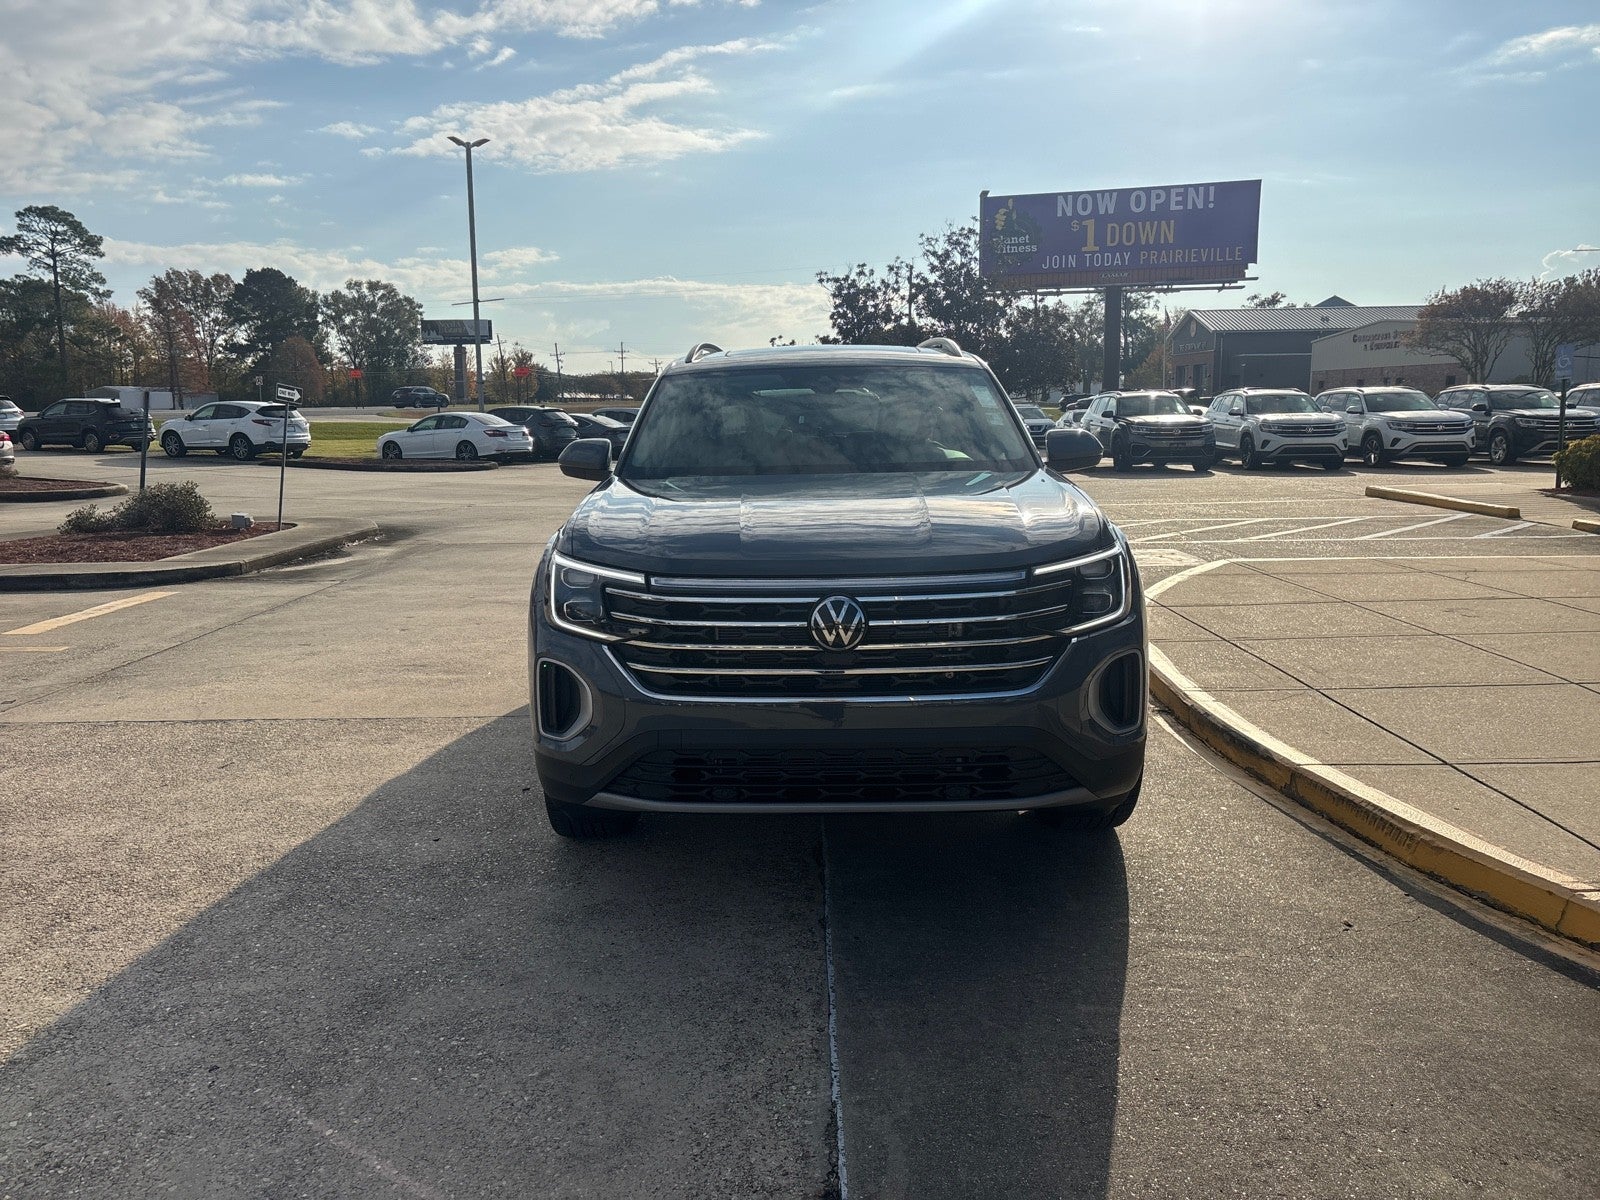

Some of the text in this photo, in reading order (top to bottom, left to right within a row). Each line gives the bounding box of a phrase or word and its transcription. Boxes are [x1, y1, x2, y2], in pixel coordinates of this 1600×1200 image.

[1057, 186, 1215, 217] NOW OPEN!
[996, 244, 1038, 254] itness
[1071, 219, 1175, 252] $1 DOWN
[1042, 247, 1243, 269] JOIN TODAY PRAIRIEVILLE
[812, 597, 863, 647] VW
